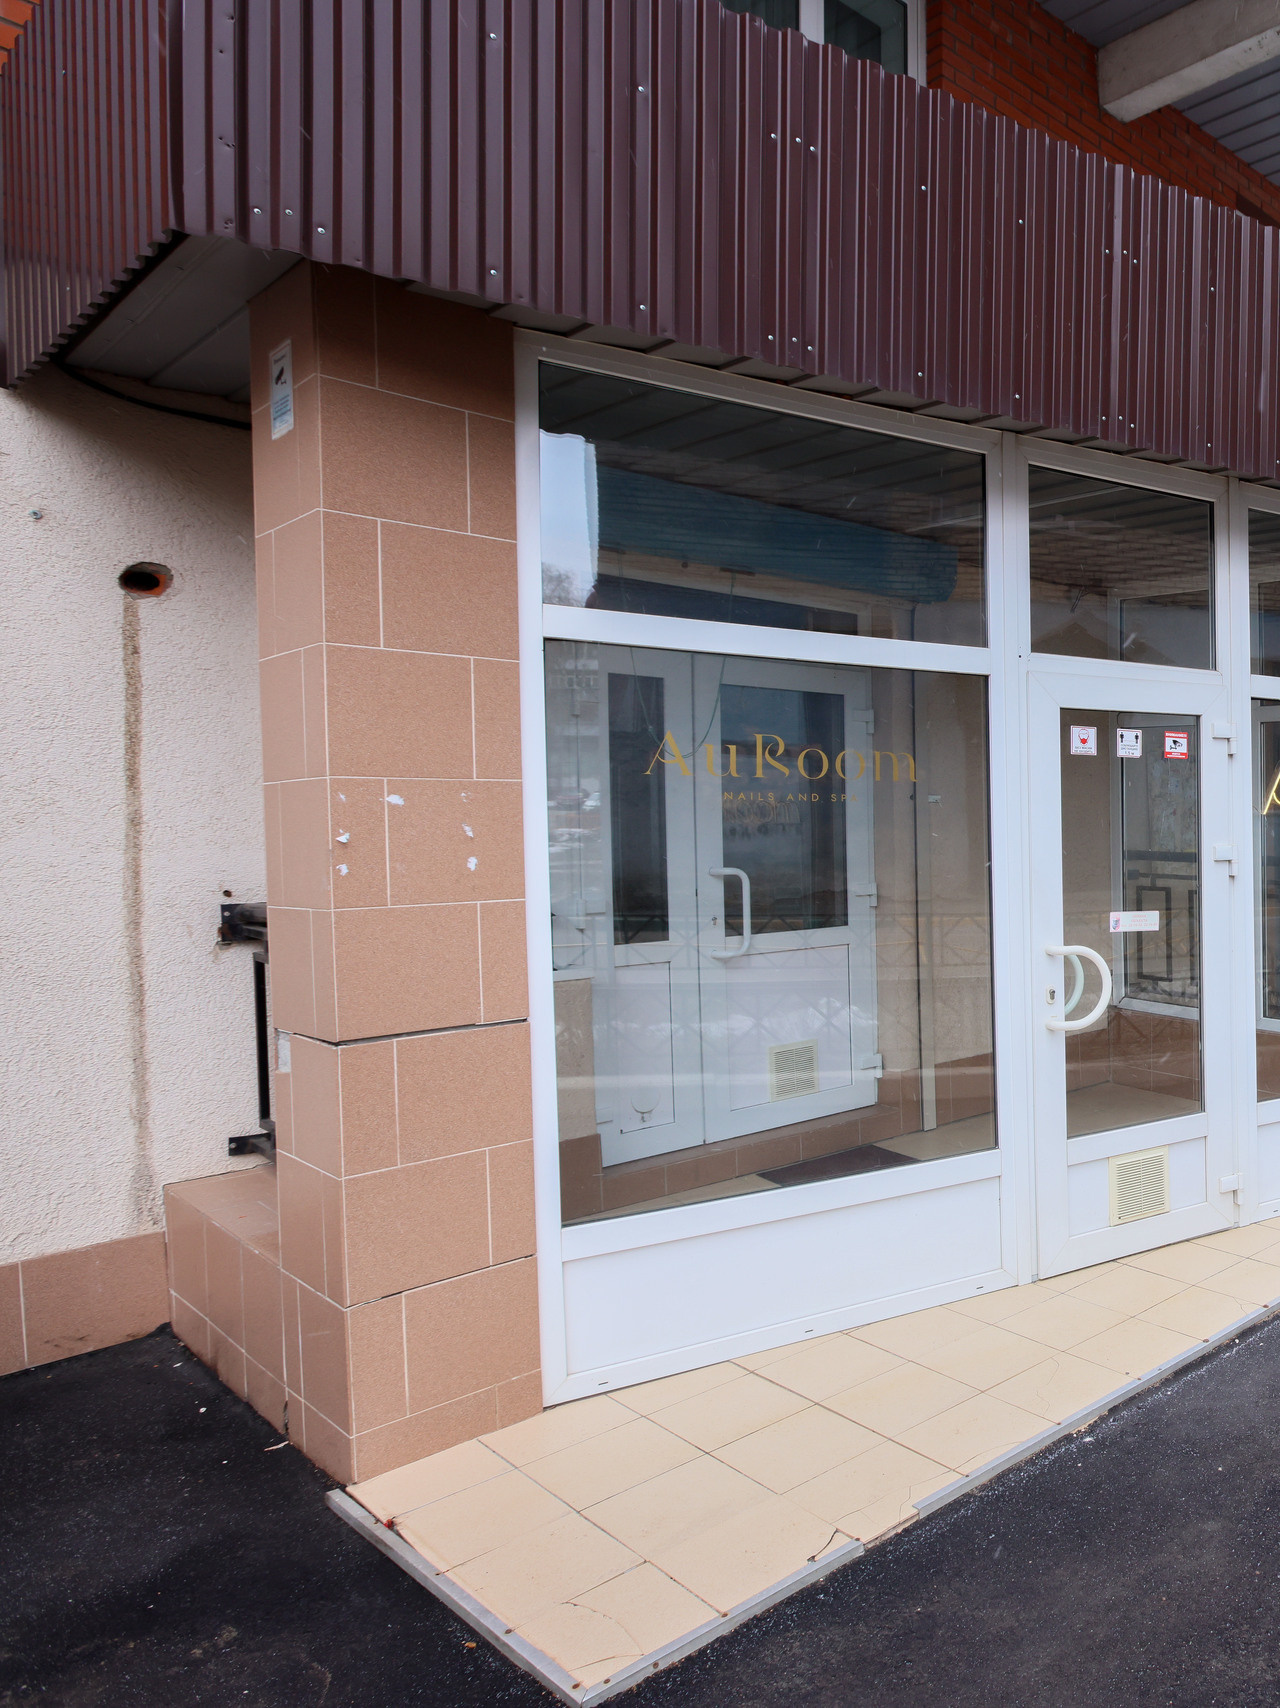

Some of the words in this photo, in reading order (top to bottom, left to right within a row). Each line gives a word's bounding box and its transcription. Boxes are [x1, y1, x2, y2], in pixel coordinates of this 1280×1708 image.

[643, 730, 918, 782] AuRoom
[724, 791, 775, 801] NAILS
[787, 793, 820, 802] AND
[831, 793, 858, 802] SPA
